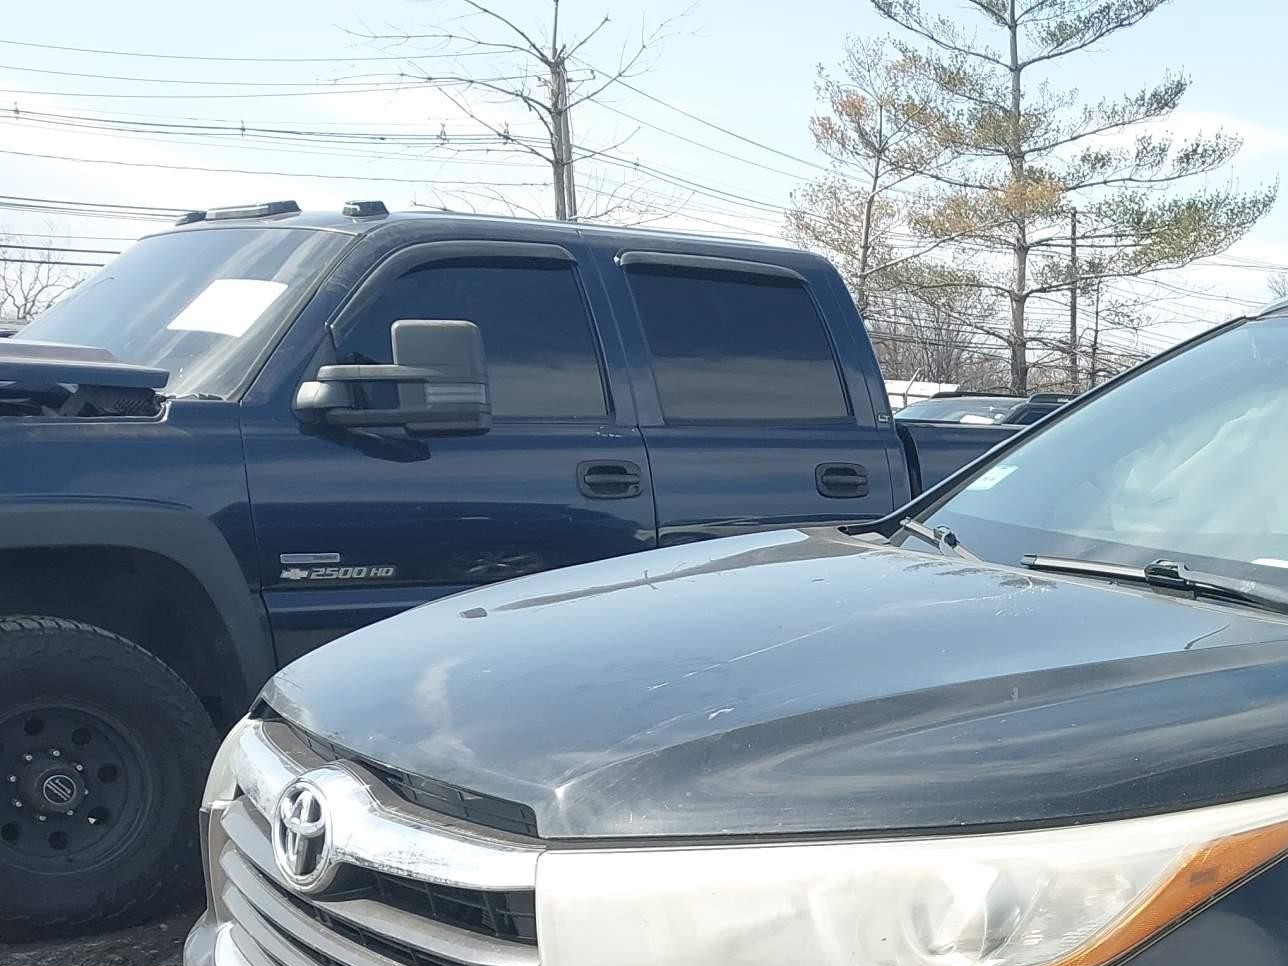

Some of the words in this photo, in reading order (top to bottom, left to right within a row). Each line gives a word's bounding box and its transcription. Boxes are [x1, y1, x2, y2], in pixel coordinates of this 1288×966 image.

[877, 414, 891, 422] LT
[310, 567, 367, 579] 2500
[369, 567, 394, 577] HD
